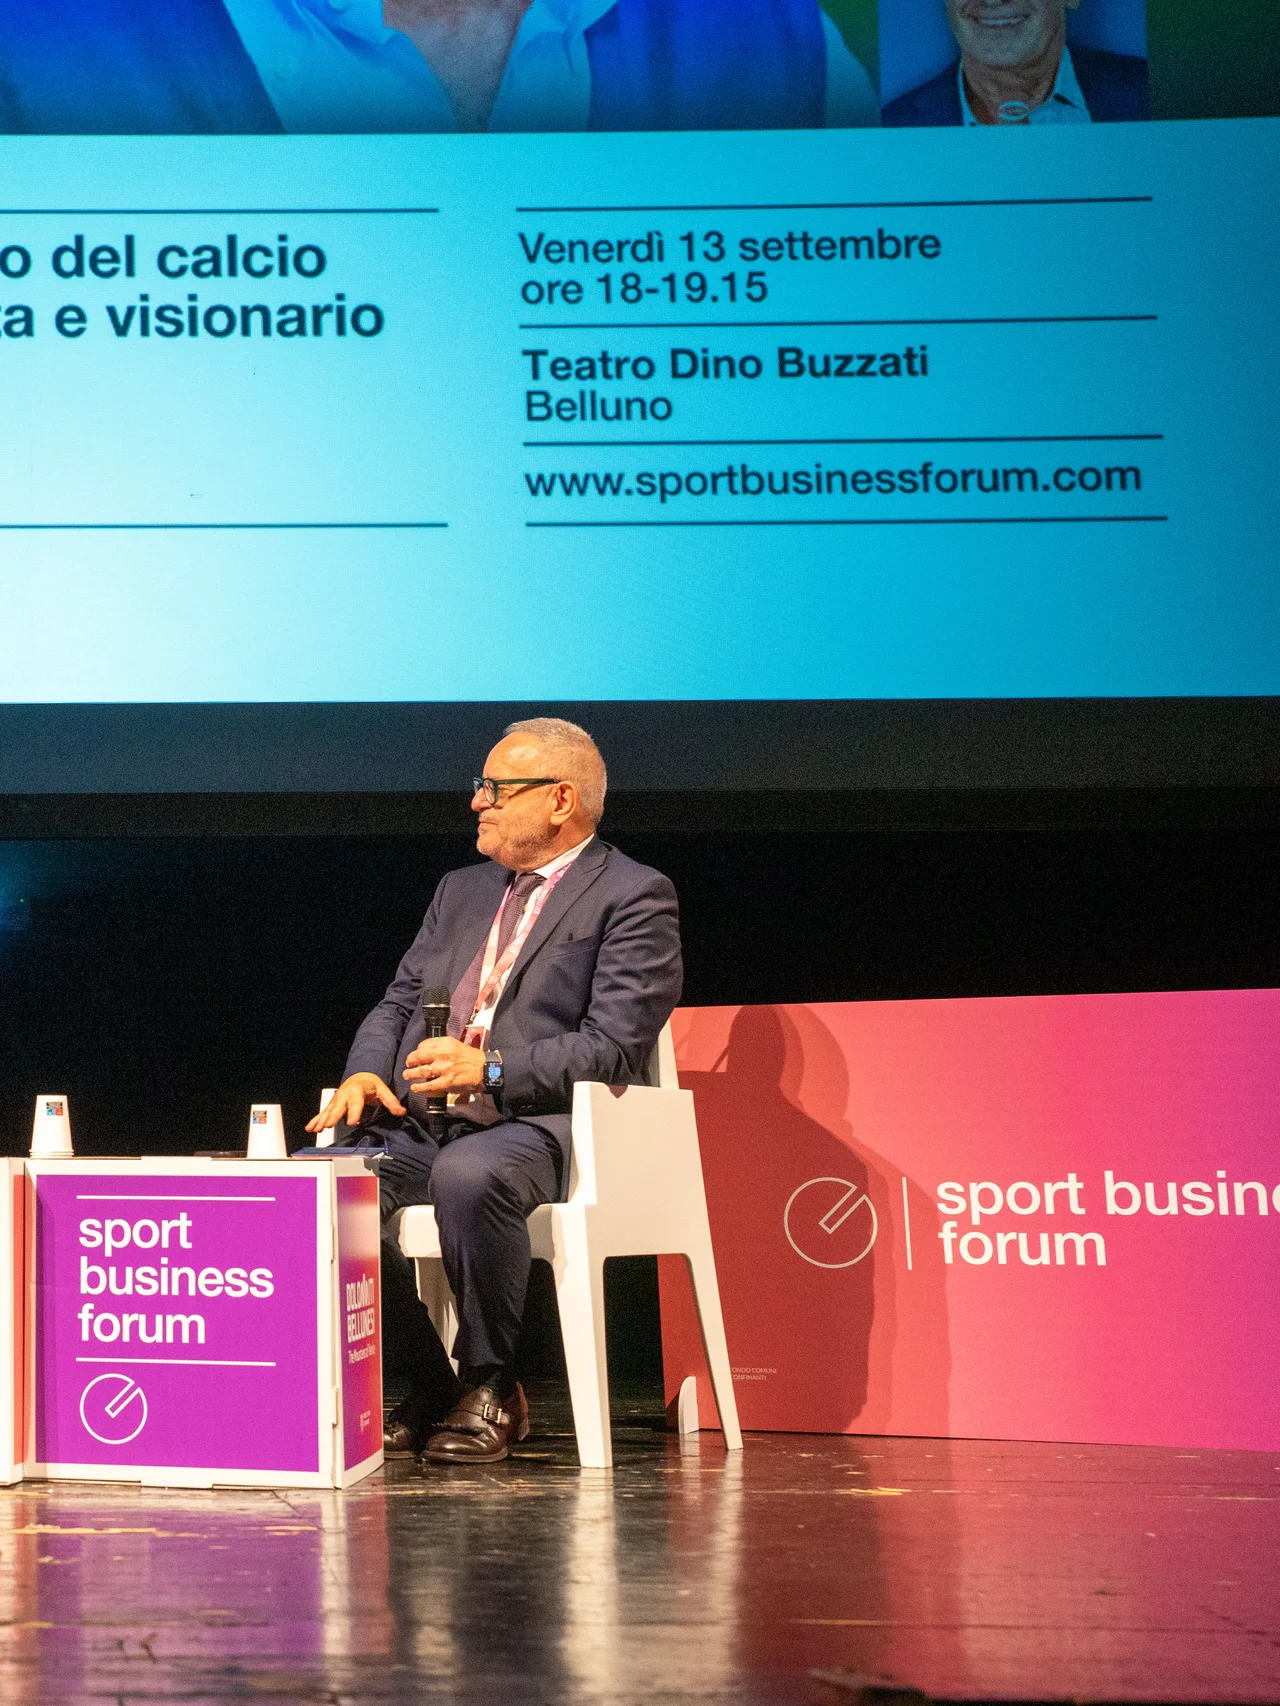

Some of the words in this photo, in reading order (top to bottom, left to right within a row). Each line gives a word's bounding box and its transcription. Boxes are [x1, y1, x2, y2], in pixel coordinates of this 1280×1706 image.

[51, 234, 136, 278] del
[157, 234, 327, 278] calcio
[518, 230, 665, 264] Venerdì
[679, 230, 726, 263] 13
[739, 227, 942, 262] settembre
[521, 279, 584, 305] ore
[597, 271, 768, 304] 18-19.15
[54, 304, 87, 339] e
[107, 293, 385, 338] visionario
[522, 349, 656, 381] Teatro
[670, 348, 763, 380] Dino
[777, 345, 928, 379] Buzzati
[526, 389, 673, 422] Belluno
[524, 462, 1142, 504] www.sportbusinessforum.com
[936, 1173, 1086, 1225] sport
[1104, 1170, 1280, 1216] busin
[78, 1212, 193, 1257] sport
[938, 1220, 1107, 1266] forum
[80, 1255, 275, 1298] business
[77, 1303, 206, 1344] forum
